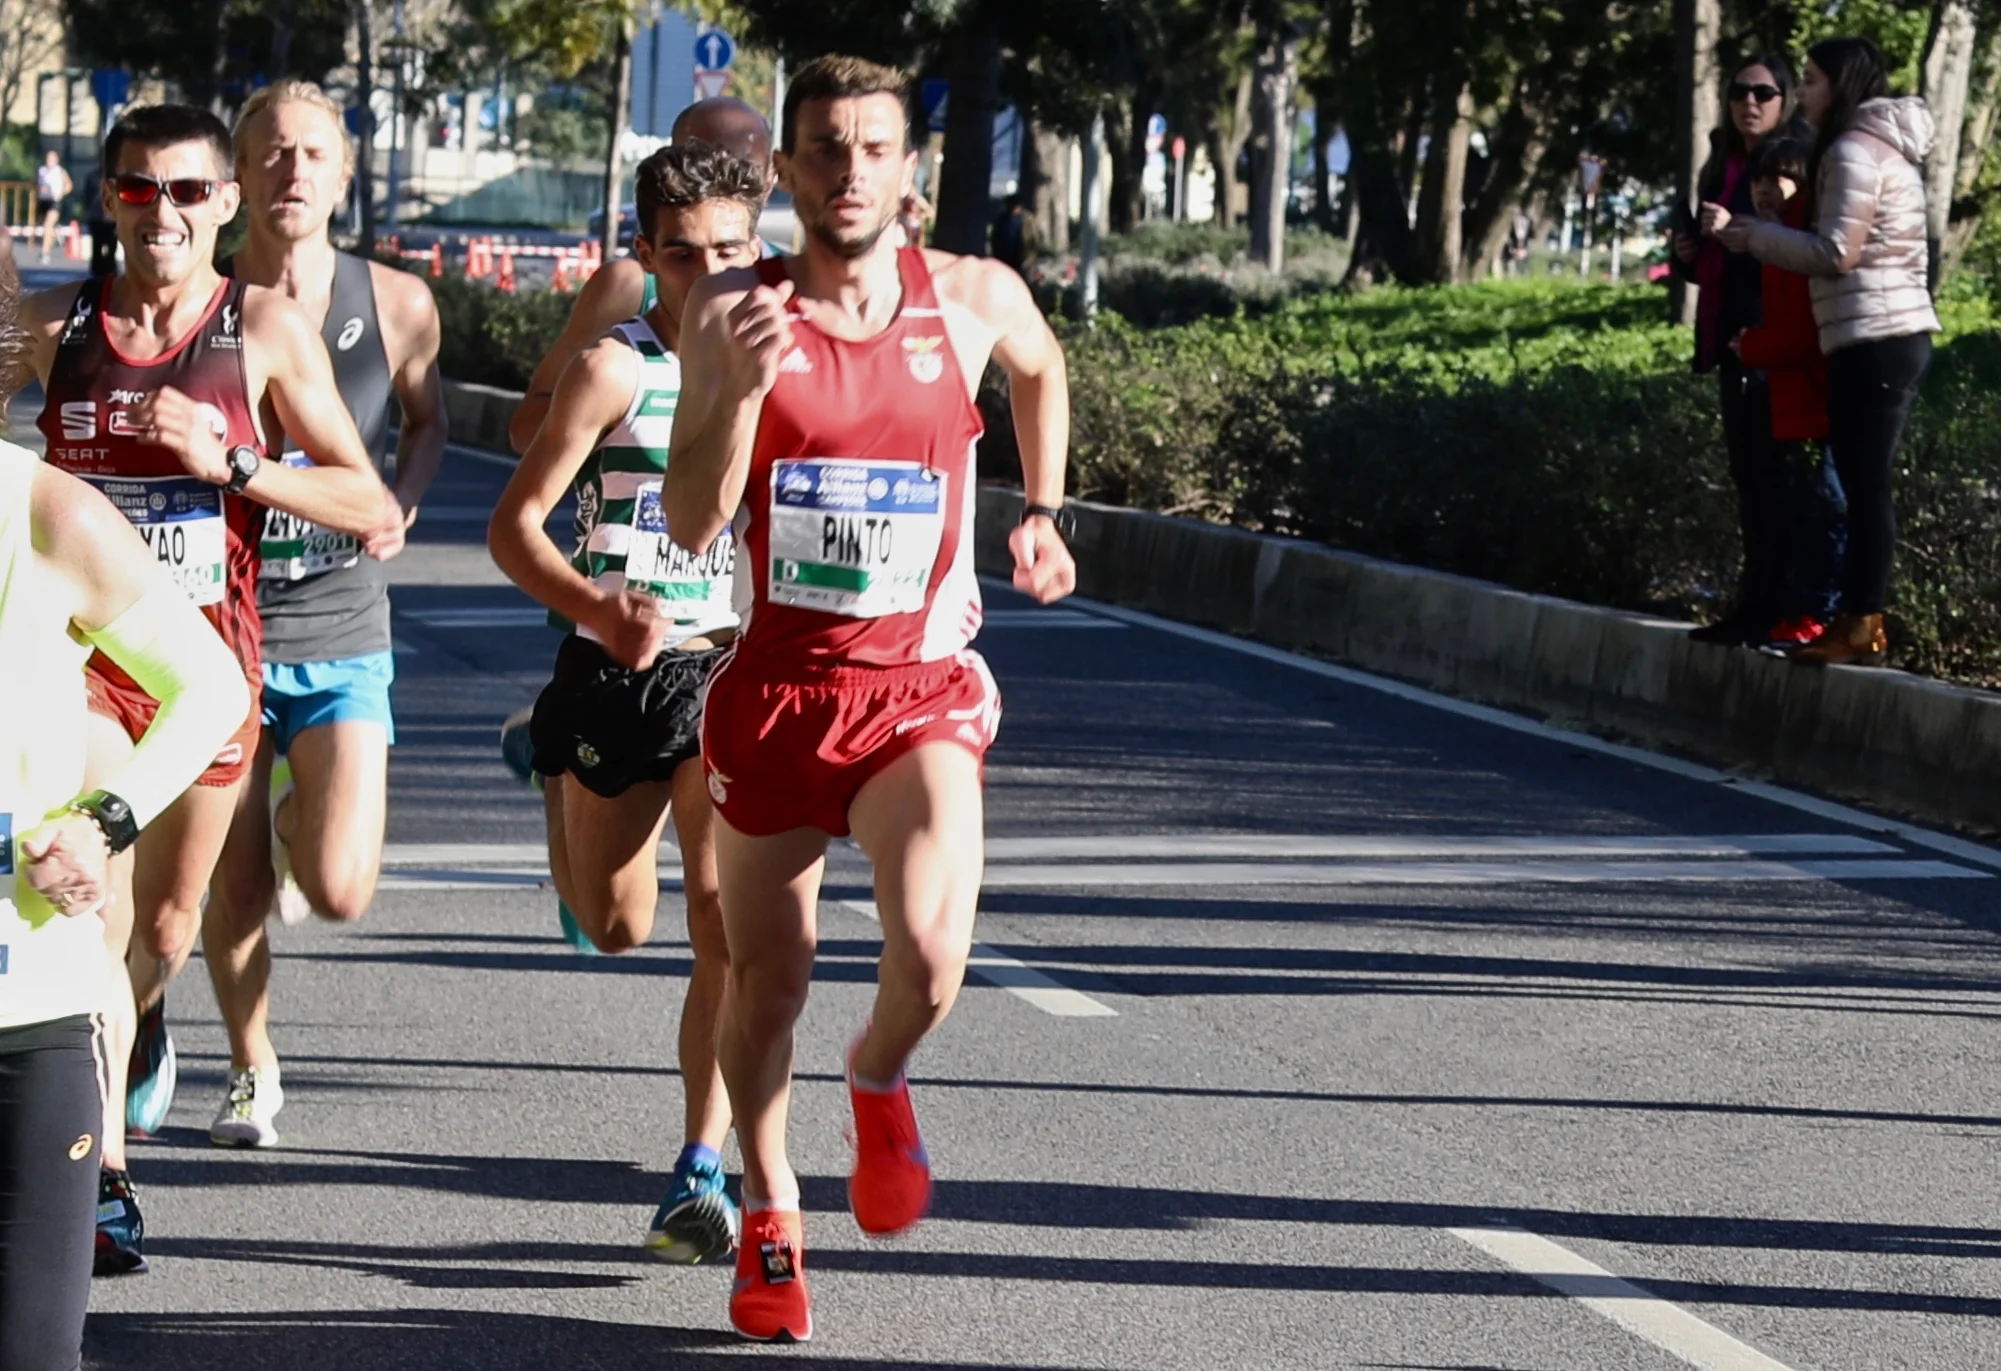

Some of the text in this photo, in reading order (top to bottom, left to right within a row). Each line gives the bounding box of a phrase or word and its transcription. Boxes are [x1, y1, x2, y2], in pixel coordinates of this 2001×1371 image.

[54, 447, 110, 461] SEAT
[103, 483, 146, 494] CORRIDA
[109, 494, 147, 507] llianz
[303, 534, 347, 554] 2901
[822, 515, 892, 564] PINTO
